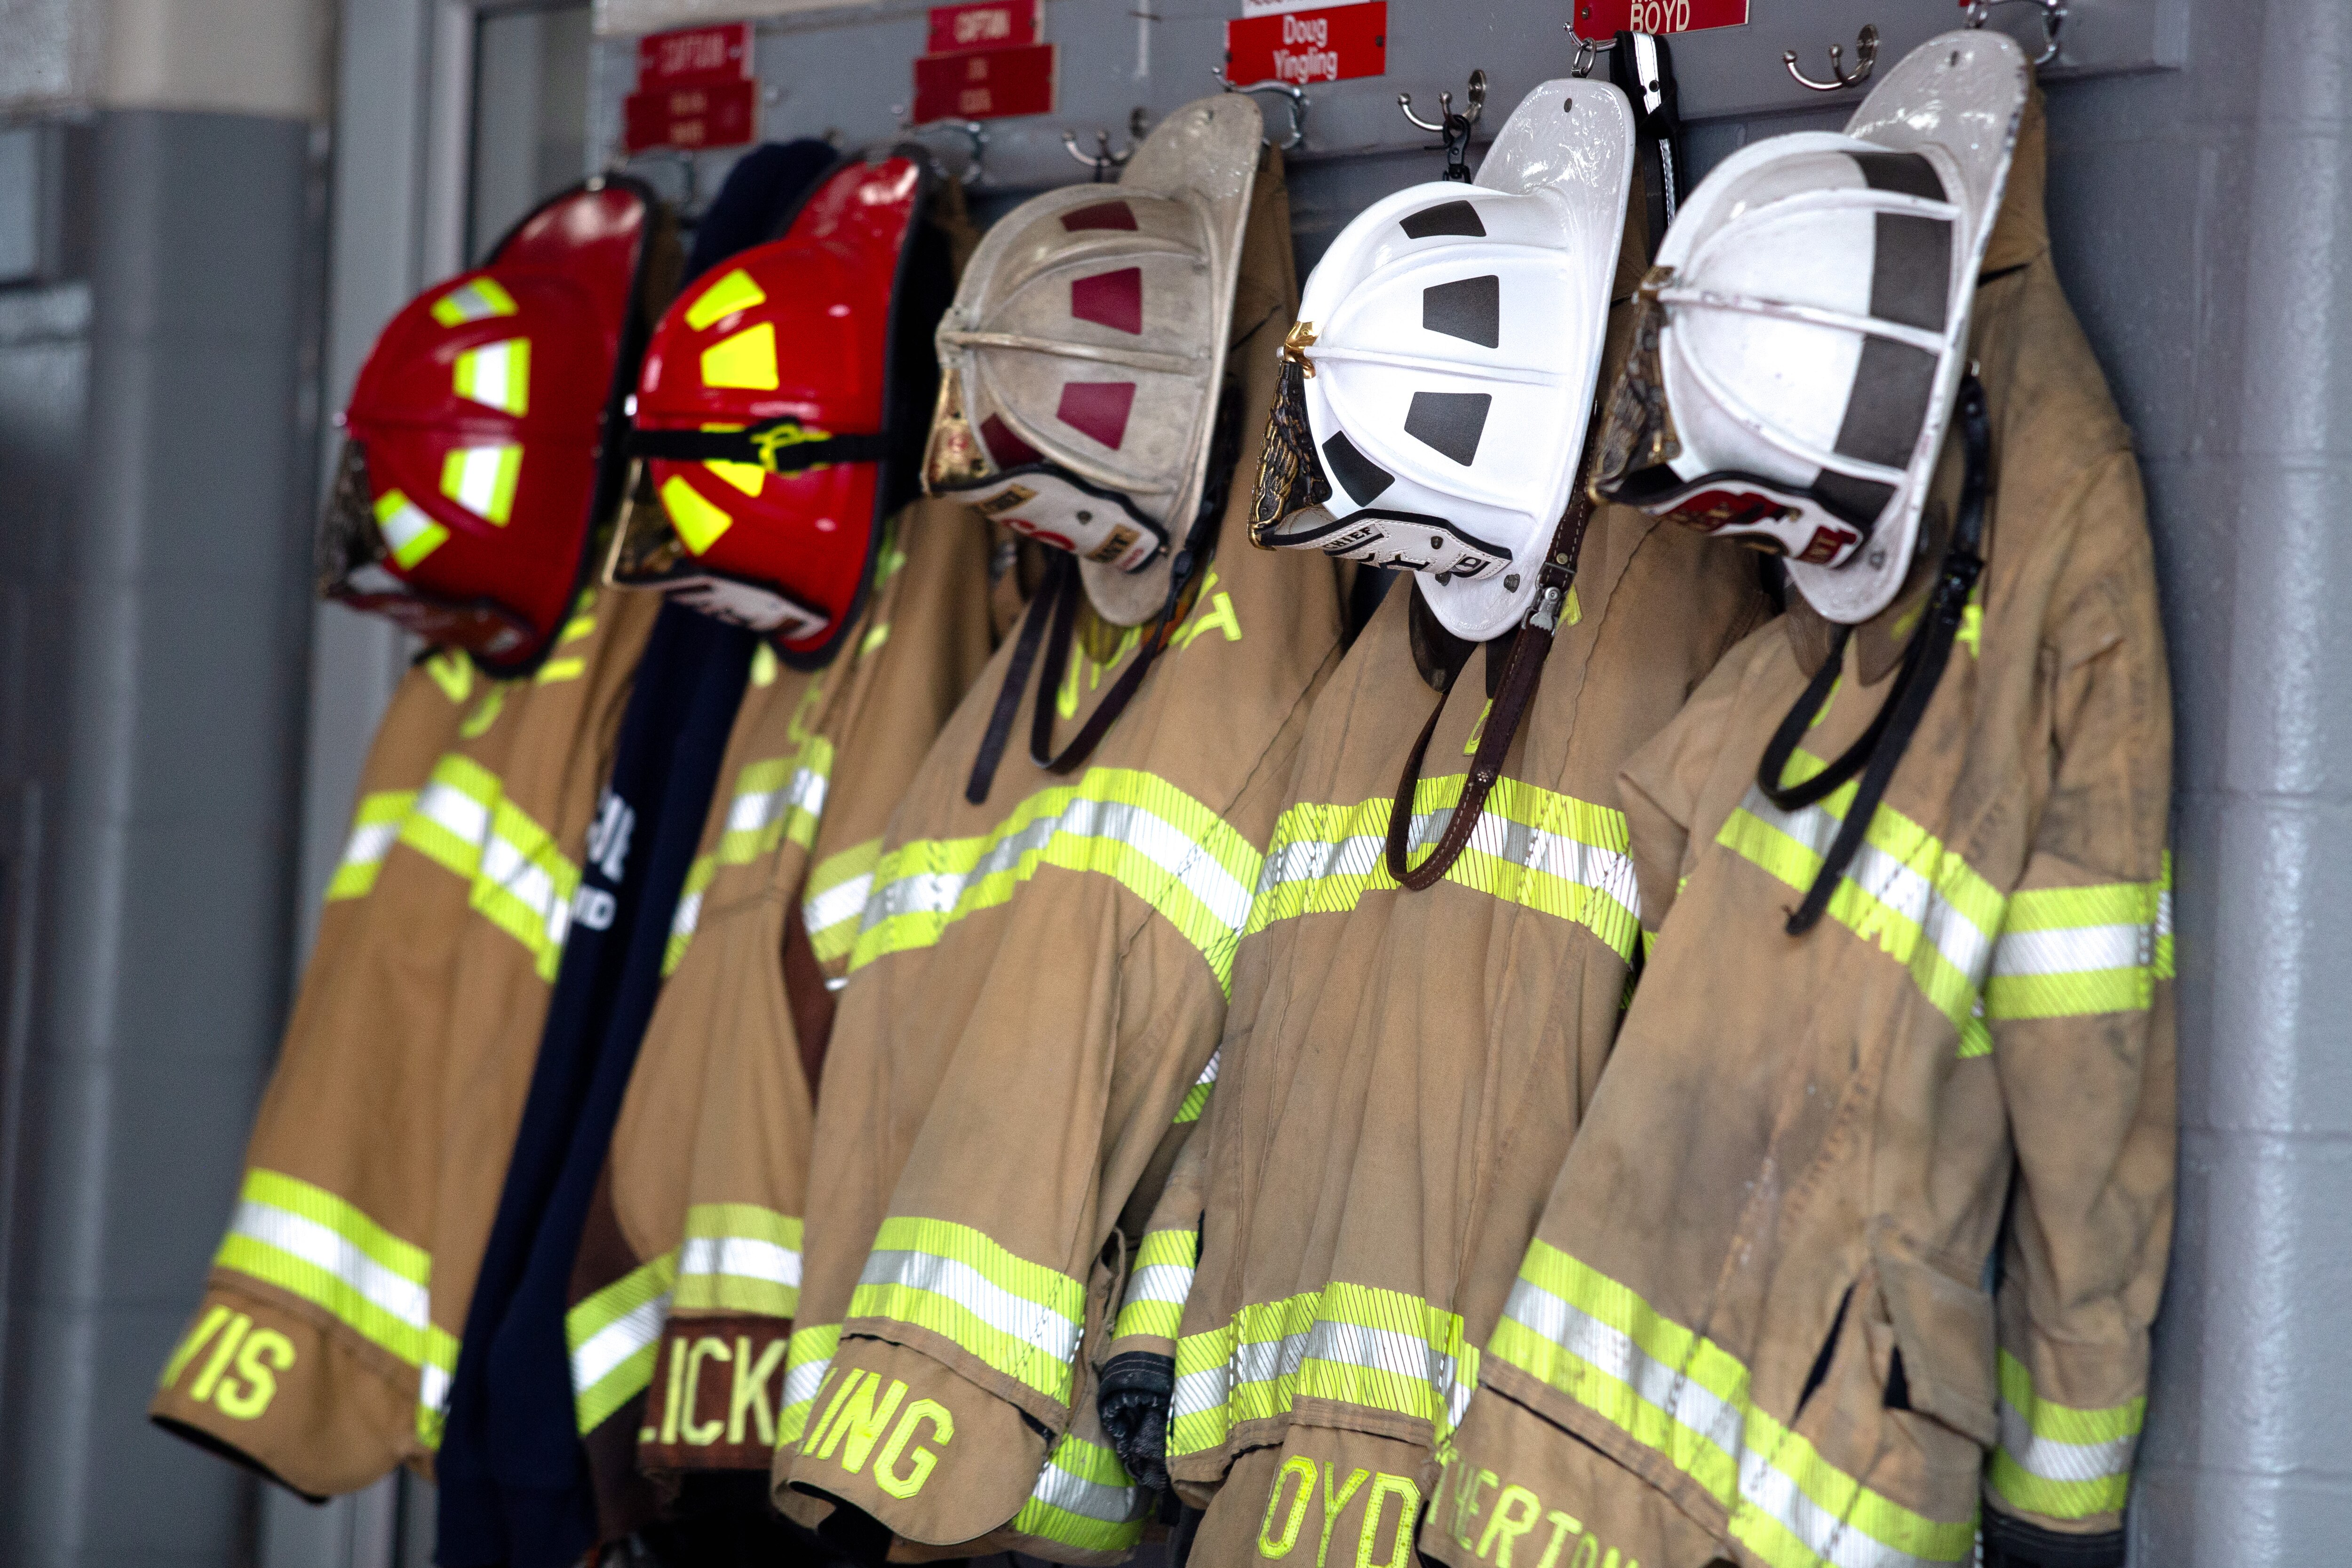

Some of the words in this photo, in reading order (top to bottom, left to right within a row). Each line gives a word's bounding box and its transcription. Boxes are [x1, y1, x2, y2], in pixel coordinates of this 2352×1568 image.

[1283, 15, 1328, 48] Doug
[1630, 0, 1690, 34] BOYD
[1272, 47, 1338, 84] Yingling
[1322, 526, 1372, 549] CHIEF
[638, 1335, 789, 1446] ICK
